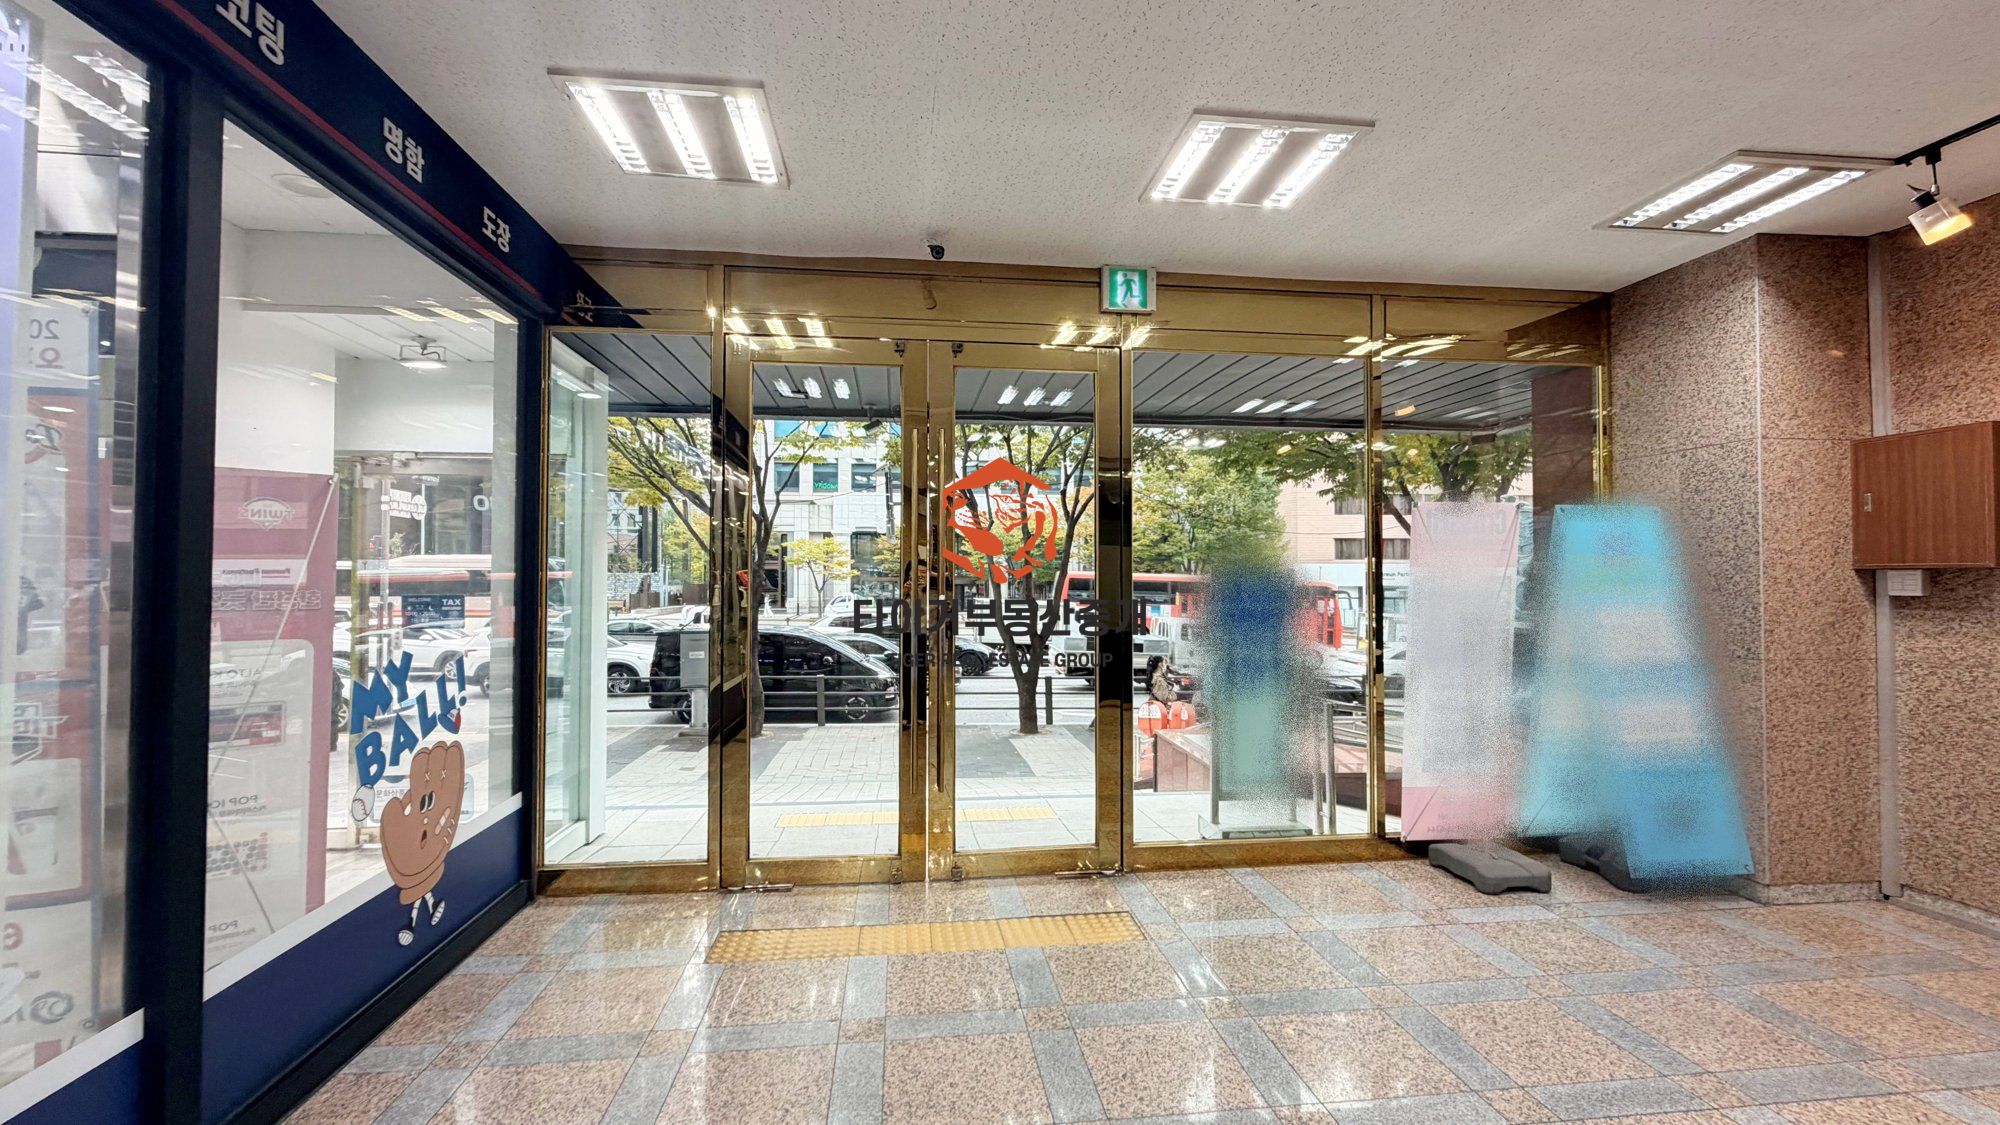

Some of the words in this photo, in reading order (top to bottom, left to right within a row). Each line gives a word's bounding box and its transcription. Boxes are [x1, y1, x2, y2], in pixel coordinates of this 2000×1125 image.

[383, 117, 425, 183] 명함
[482, 206, 511, 253] 도장
[441, 598, 462, 606] TAX
[853, 599, 1147, 637] 타이거부동산중개
[1055, 652, 1113, 668] GROUP
[350, 650, 414, 735] MY
